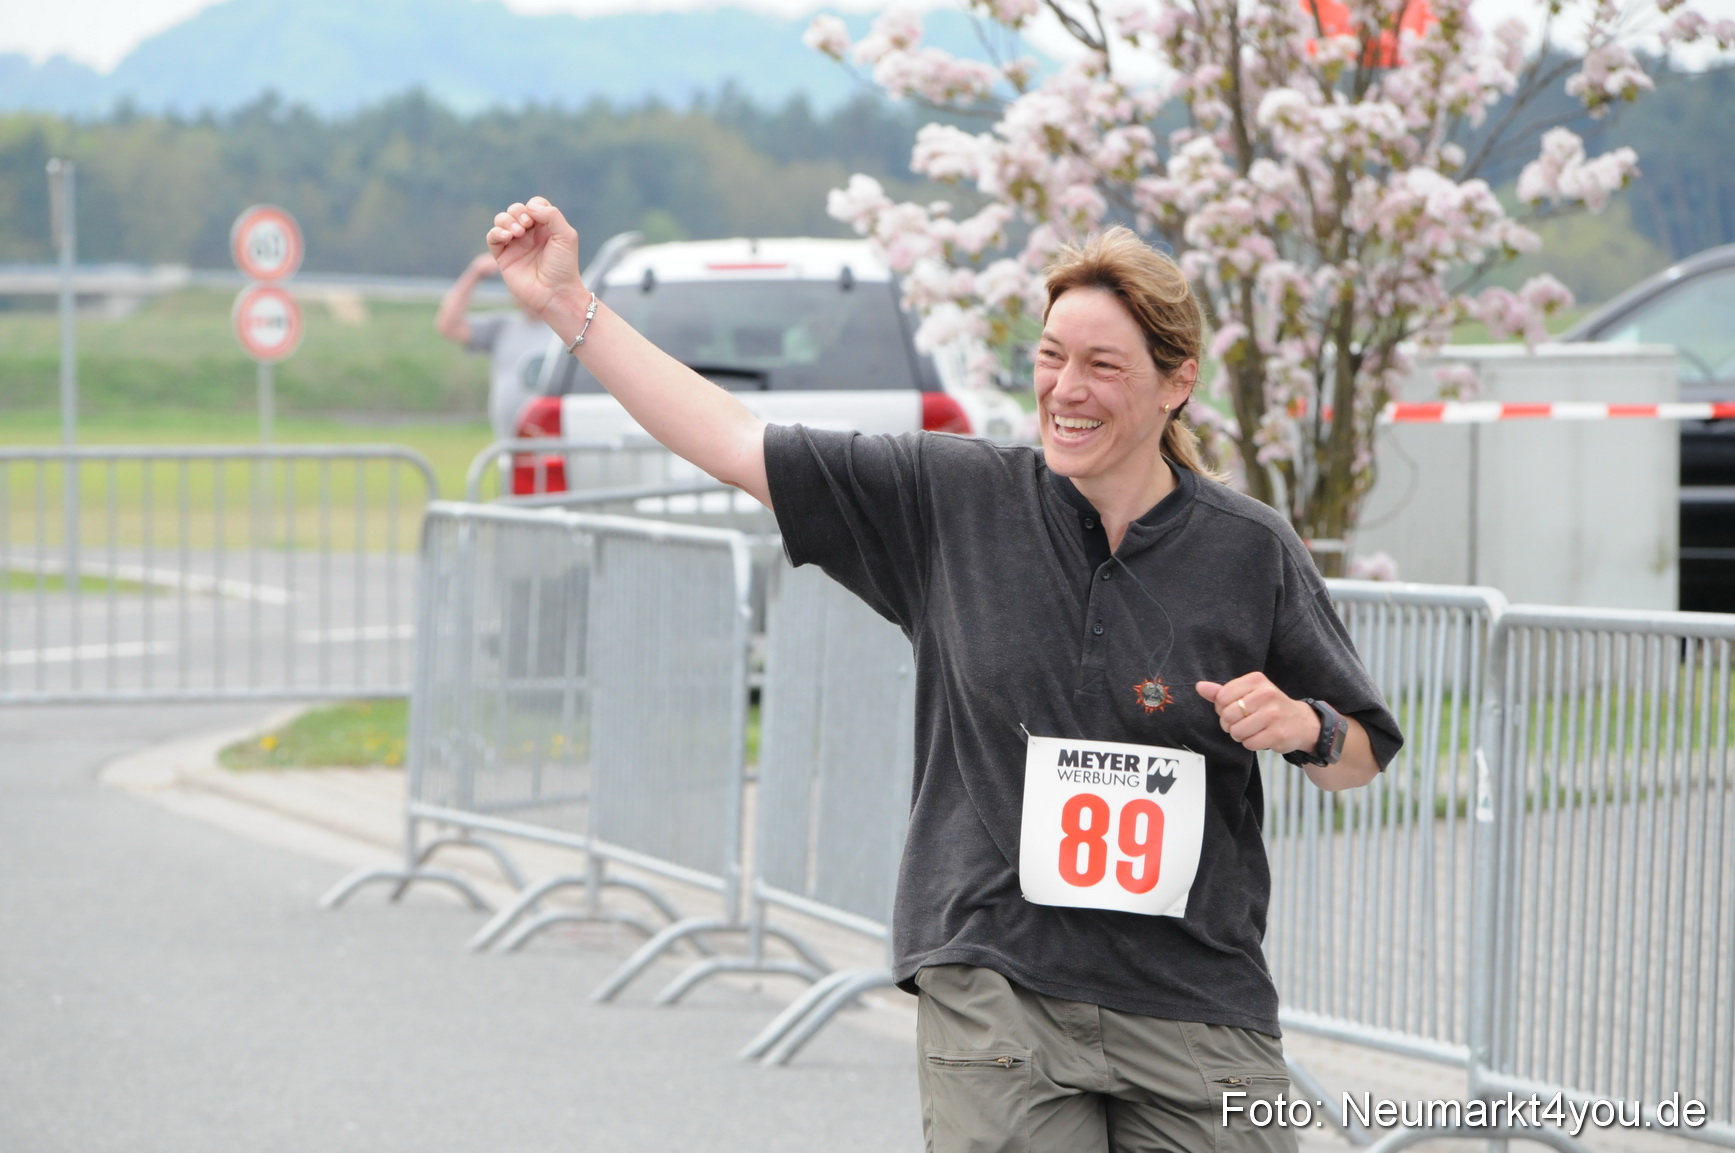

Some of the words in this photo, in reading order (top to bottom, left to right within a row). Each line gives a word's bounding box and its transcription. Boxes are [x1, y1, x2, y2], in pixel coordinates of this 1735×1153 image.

[1057, 749, 1140, 773] MEYER
[1057, 768, 1140, 788] WERBUNG
[1058, 792, 1165, 895] 89
